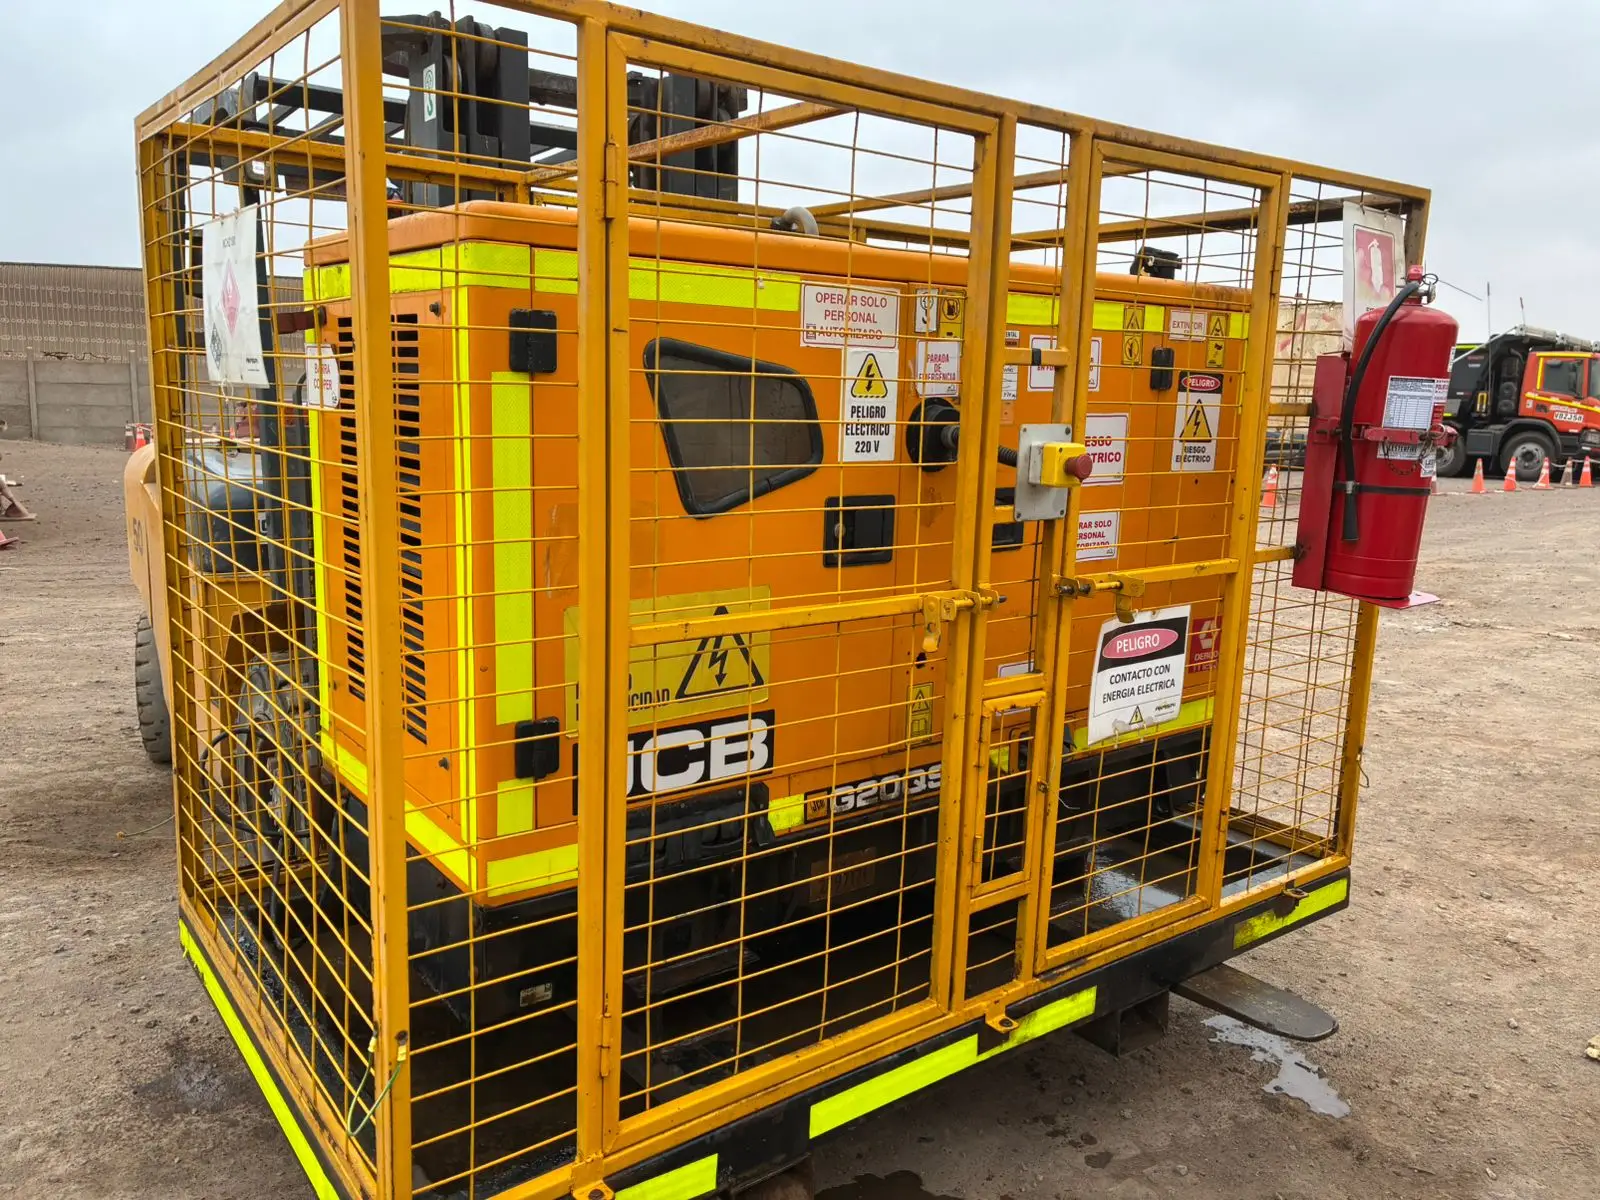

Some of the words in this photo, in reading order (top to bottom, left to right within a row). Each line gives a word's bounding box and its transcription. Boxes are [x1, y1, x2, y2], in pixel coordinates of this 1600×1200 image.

[860, 295, 888, 309] SOLO
[823, 309, 878, 324] PERSONAL
[1172, 320, 1203, 331] EXTINOR
[918, 372, 956, 381] EERGENCIA
[313, 378, 333, 391] COPER
[850, 405, 887, 419] PELIGRO
[855, 440, 872, 453] 220
[873, 440, 880, 453] V
[1084, 435, 1113, 447] ESGO
[1088, 452, 1122, 463] TRICO
[1078, 521, 1093, 530] RAR
[1094, 519, 1112, 529] SOLO
[1078, 531, 1106, 540] RSONAL
[1076, 541, 1110, 549] TORIZADO
[1116, 633, 1160, 654] PELIGRO
[1109, 668, 1153, 685] CONTACTO
[1153, 663, 1171, 679] CON
[1102, 687, 1136, 704] ENERGIA
[1137, 678, 1176, 696] ELECTRICA
